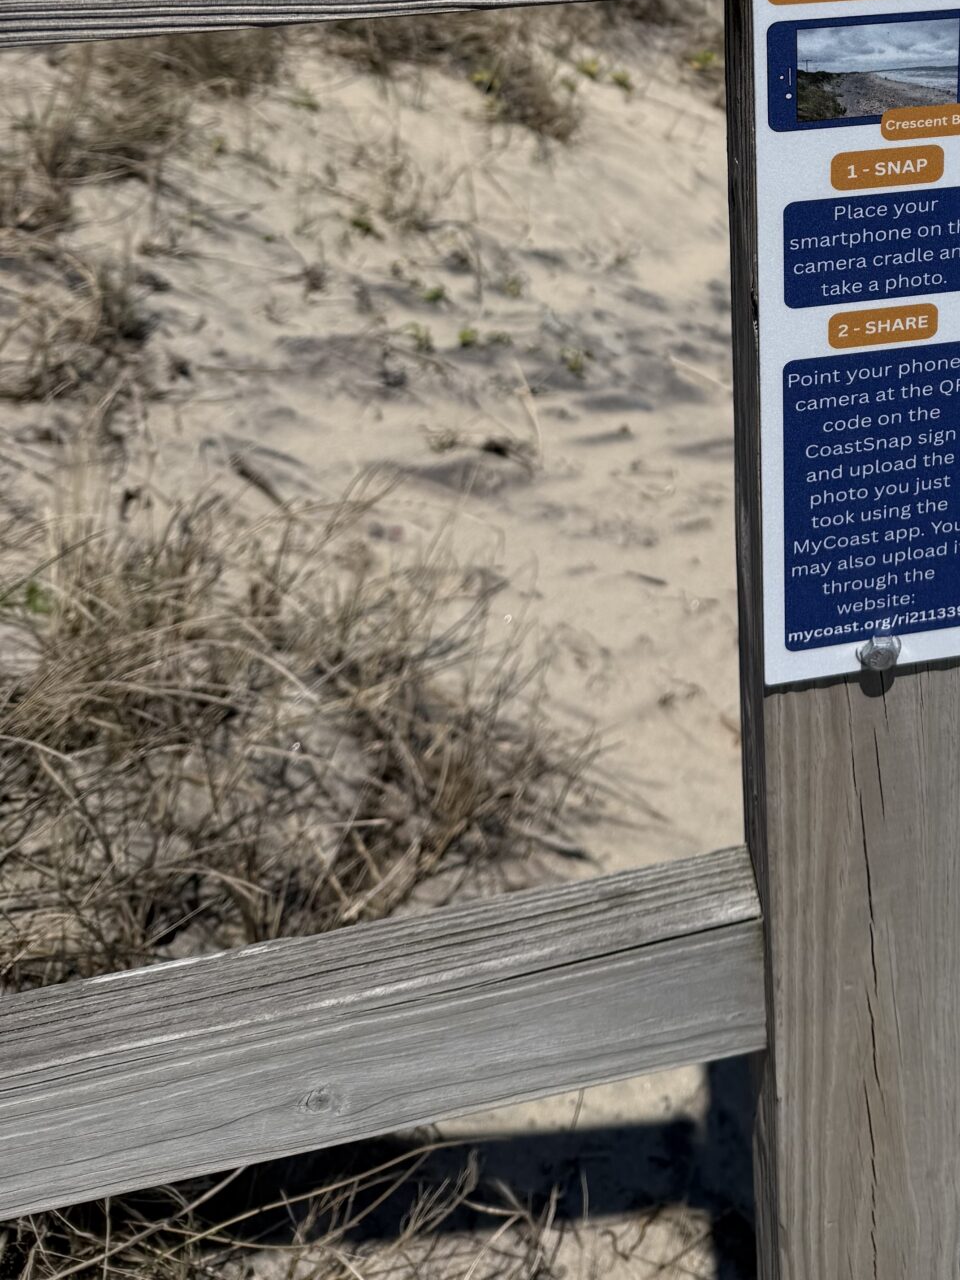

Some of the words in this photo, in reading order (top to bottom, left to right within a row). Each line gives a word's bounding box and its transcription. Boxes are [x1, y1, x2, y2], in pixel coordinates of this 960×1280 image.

[886, 116, 948, 130] Crescent
[847, 165, 857, 179] 1
[875, 159, 927, 176] SNAP
[834, 202, 887, 220] Place
[893, 199, 938, 218] your
[790, 227, 912, 250] smartphone
[917, 224, 941, 237] on
[793, 255, 867, 275] camera
[873, 248, 933, 267] cradle
[821, 279, 863, 296] take
[868, 279, 879, 291] a
[885, 274, 947, 292] photo.
[838, 325, 848, 337] 2
[865, 316, 928, 335] SHARE
[788, 369, 840, 388] Point
[846, 365, 892, 385] your
[795, 391, 870, 411] camera
[876, 388, 895, 401] at
[901, 383, 933, 398] the
[823, 415, 872, 432] code
[878, 412, 902, 426] on
[909, 407, 941, 422] the
[806, 433, 912, 459] CoastSnap
[918, 428, 956, 449] sign
[806, 465, 843, 482] and
[850, 457, 916, 483] upload
[923, 452, 955, 468] the
[810, 486, 868, 509] photo
[874, 485, 909, 504] you
[914, 476, 951, 496] just
[812, 510, 854, 528] took
[861, 503, 911, 525] using
[917, 498, 948, 514] the
[794, 531, 879, 555] MyCoast
[885, 526, 925, 545] app.
[792, 559, 831, 578] may
[838, 553, 876, 570] also
[882, 543, 947, 566] upload
[823, 573, 898, 594] through
[904, 568, 935, 583] the
[837, 593, 915, 615] website:
